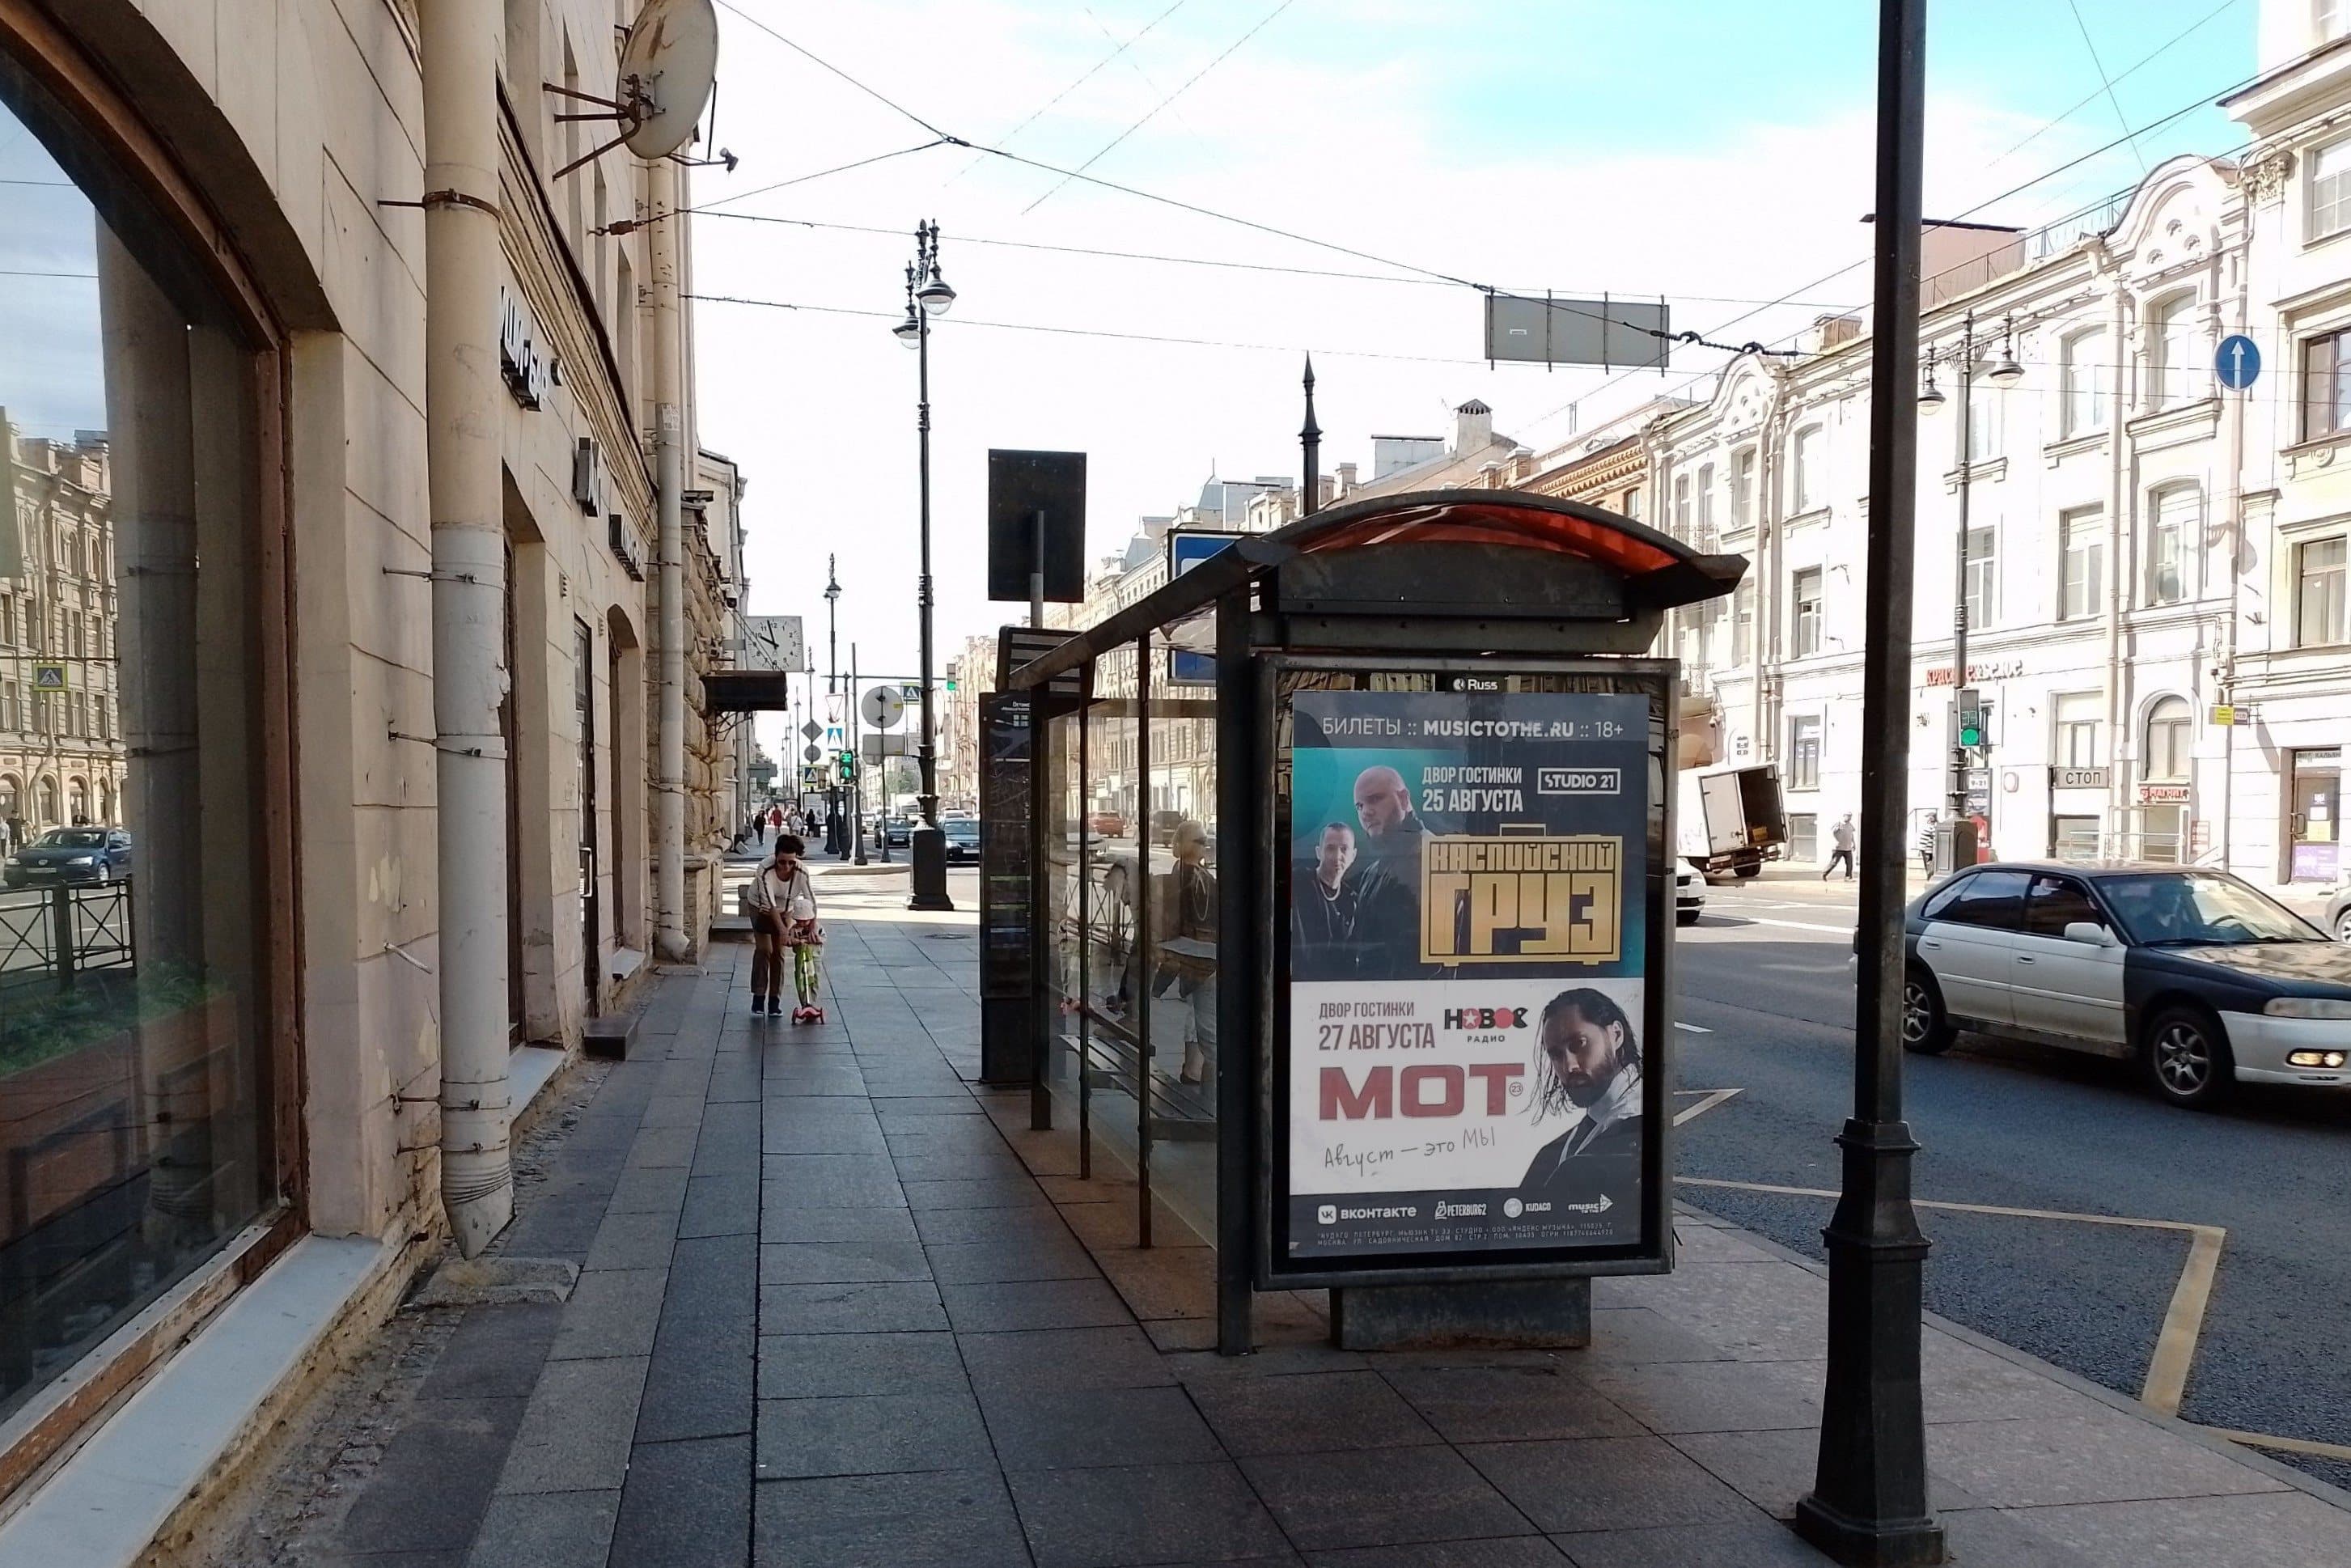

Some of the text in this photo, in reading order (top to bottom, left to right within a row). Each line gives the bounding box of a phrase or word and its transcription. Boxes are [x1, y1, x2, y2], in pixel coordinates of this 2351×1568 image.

[1468, 679, 1497, 690] Russ
[1323, 717, 1400, 735] БИЛЕТЫ
[1423, 720, 1574, 738] MUSICTOTHE.RU
[1595, 721, 1623, 738] 18+
[1421, 766, 1522, 785] ДВОР ГОСТИНКИ
[1544, 773, 1614, 788] STUDIO 21
[2065, 772, 2100, 785] СТОП
[1422, 788, 1523, 812] 25 АВГУСТА
[1430, 843, 1615, 871] КАСПИЙСКИЙ
[1430, 872, 1614, 954] ГРУЗ
[1319, 1002, 1414, 1019] ДВОР ГОСТИНКИ
[1319, 1023, 1435, 1050] 27 АВГУСТА
[1468, 1035, 1506, 1043] РАДИО
[1319, 1062, 1525, 1121] МОТ
[1324, 1143, 1394, 1177] Август
[1424, 1141, 1455, 1156] это
[1463, 1126, 1495, 1149] МЫ
[1340, 1206, 1417, 1220] вконтакте
[1568, 1202, 1599, 1211] music
